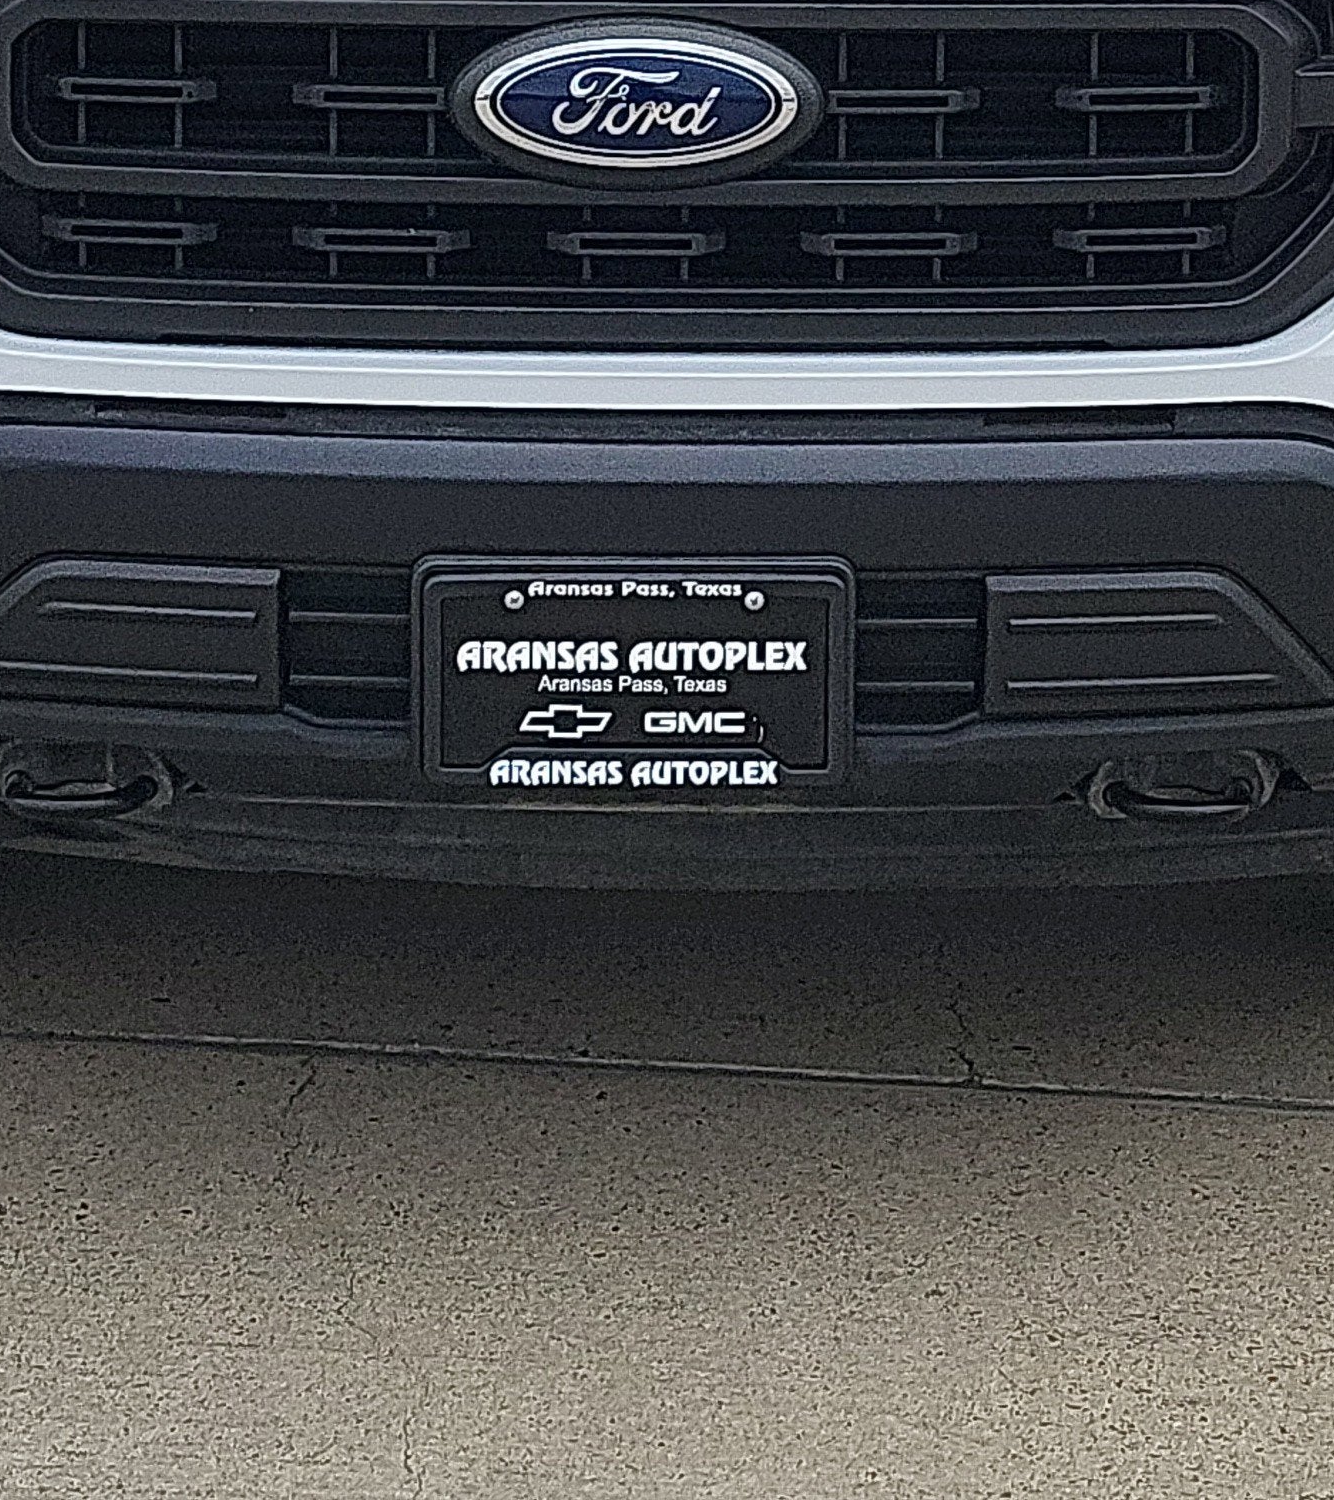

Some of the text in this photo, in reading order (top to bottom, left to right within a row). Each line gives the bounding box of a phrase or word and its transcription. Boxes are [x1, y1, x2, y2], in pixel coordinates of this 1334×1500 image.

[552, 67, 722, 135] Ford
[528, 581, 743, 598] Aransas Pass, Texas
[456, 641, 807, 673] ARANSAS AUTOPLEX
[537, 674, 727, 695] Aransas Pass, Texas
[644, 711, 746, 734] GMC
[489, 759, 778, 787] ARANSAS AUTOPLEX
